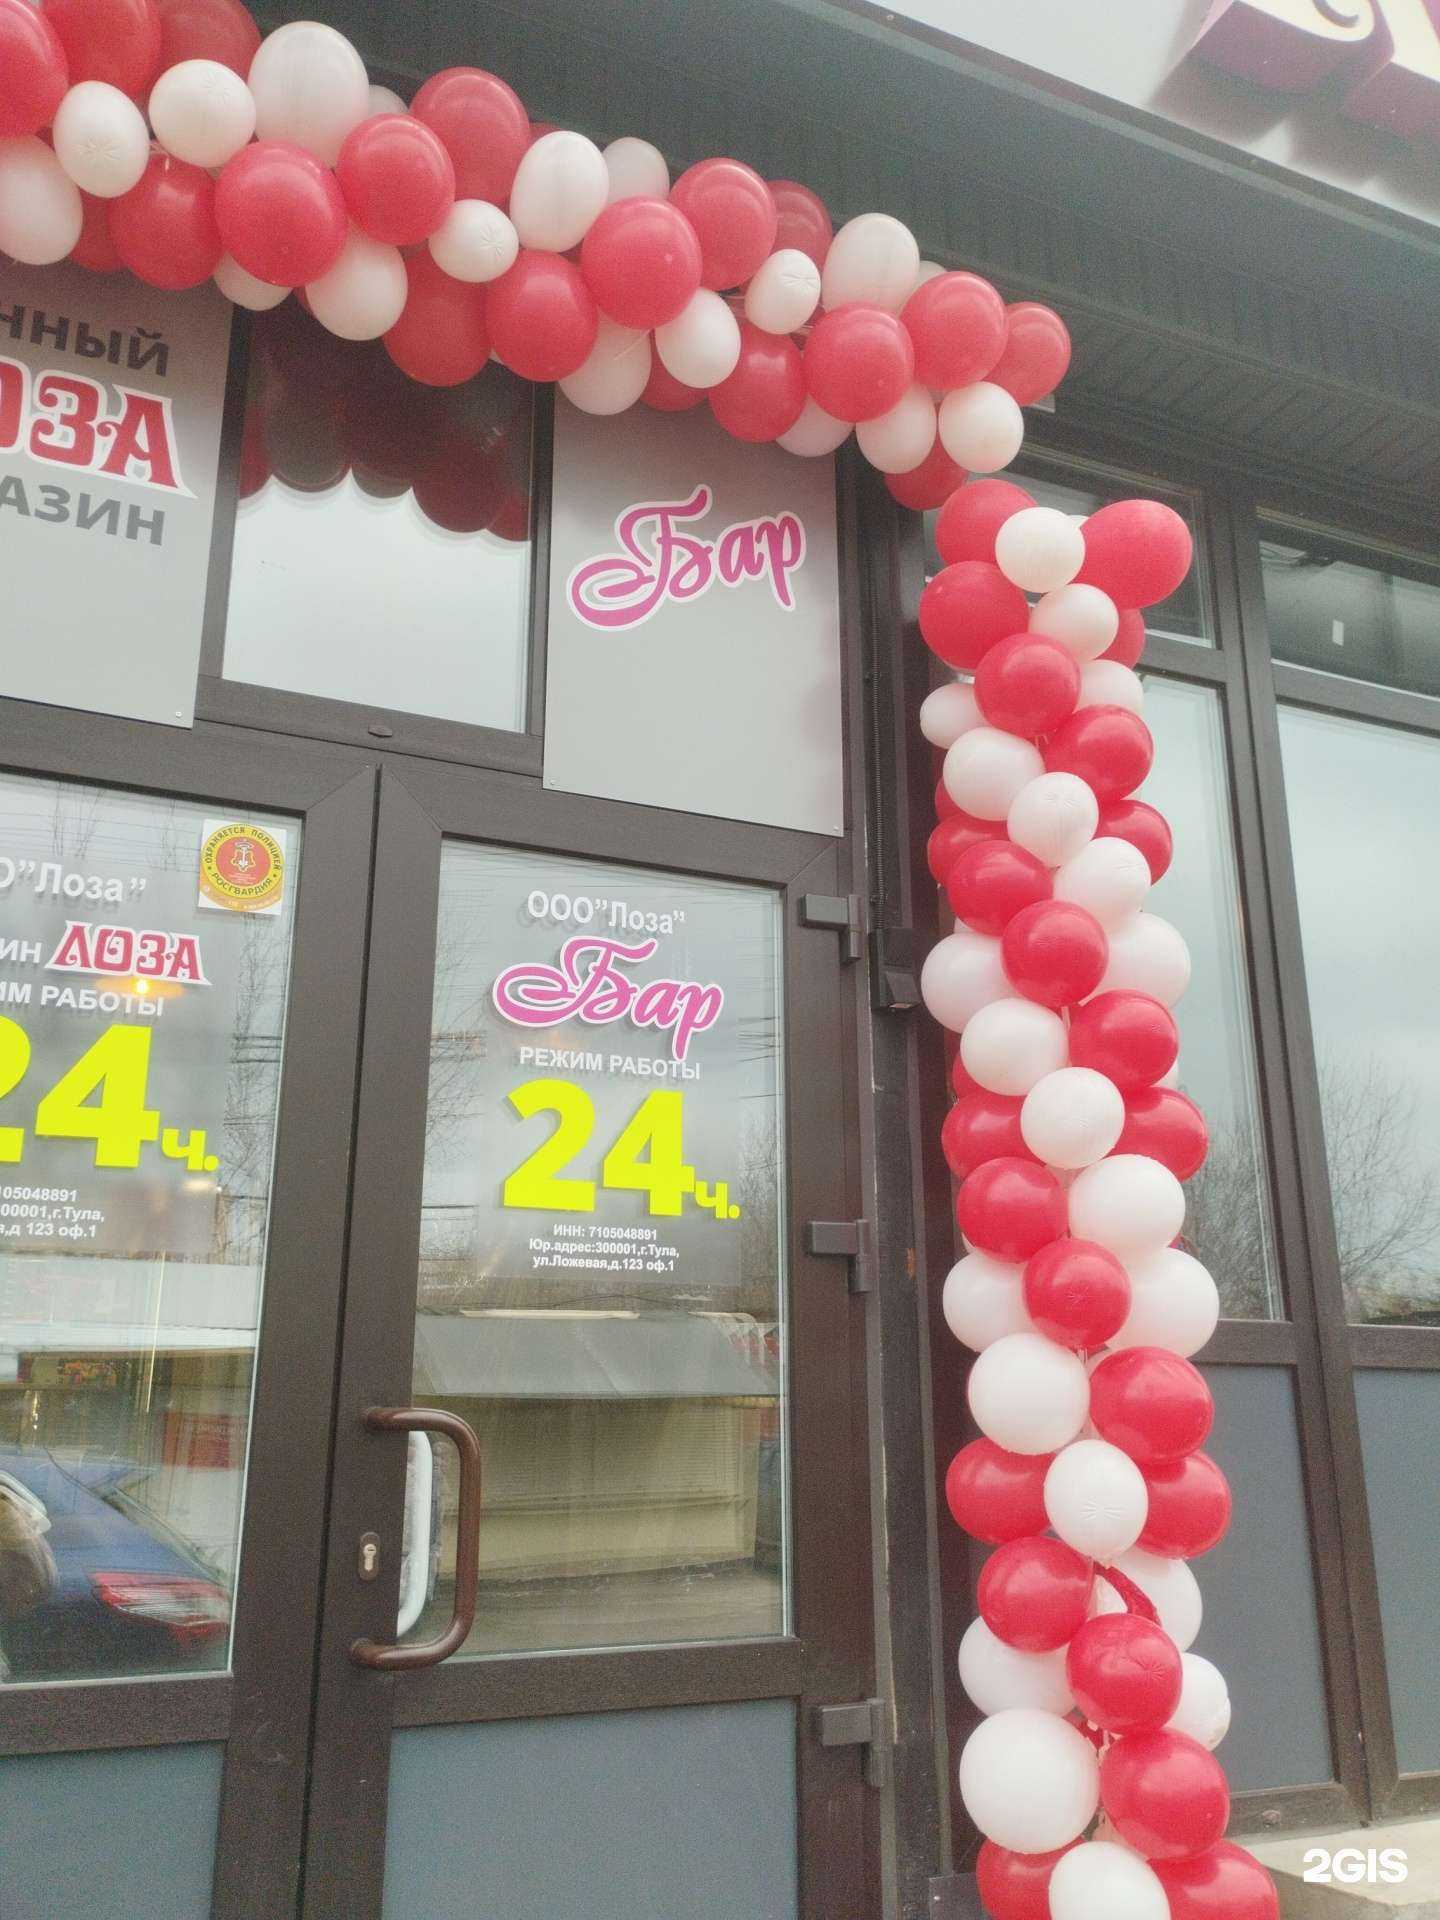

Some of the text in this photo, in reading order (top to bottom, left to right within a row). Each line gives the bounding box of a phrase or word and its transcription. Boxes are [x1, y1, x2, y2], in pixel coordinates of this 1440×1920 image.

[0, 356, 198, 498] ЗА
[0, 475, 165, 546] АЗИН
[567, 484, 806, 631] Бар
[204, 826, 246, 864] ОХРАНЯЕТСЯ
[212, 872, 273, 895] РОСГВАРДИЯ
[44, 920, 212, 986] ЛОЗА
[41, 985, 164, 1016] РАБОТЫ
[493, 935, 724, 1061] Бар
[519, 1046, 700, 1080] РЕЖИМ РАБОТЫ
[0, 1186, 77, 1202] 05048891
[26, 1222, 54, 1236] 123
[58, 1223, 96, 1240] оф.1
[553, 1224, 657, 1241] ИНН: 7105048891
[646, 1259, 674, 1273] оф.1
